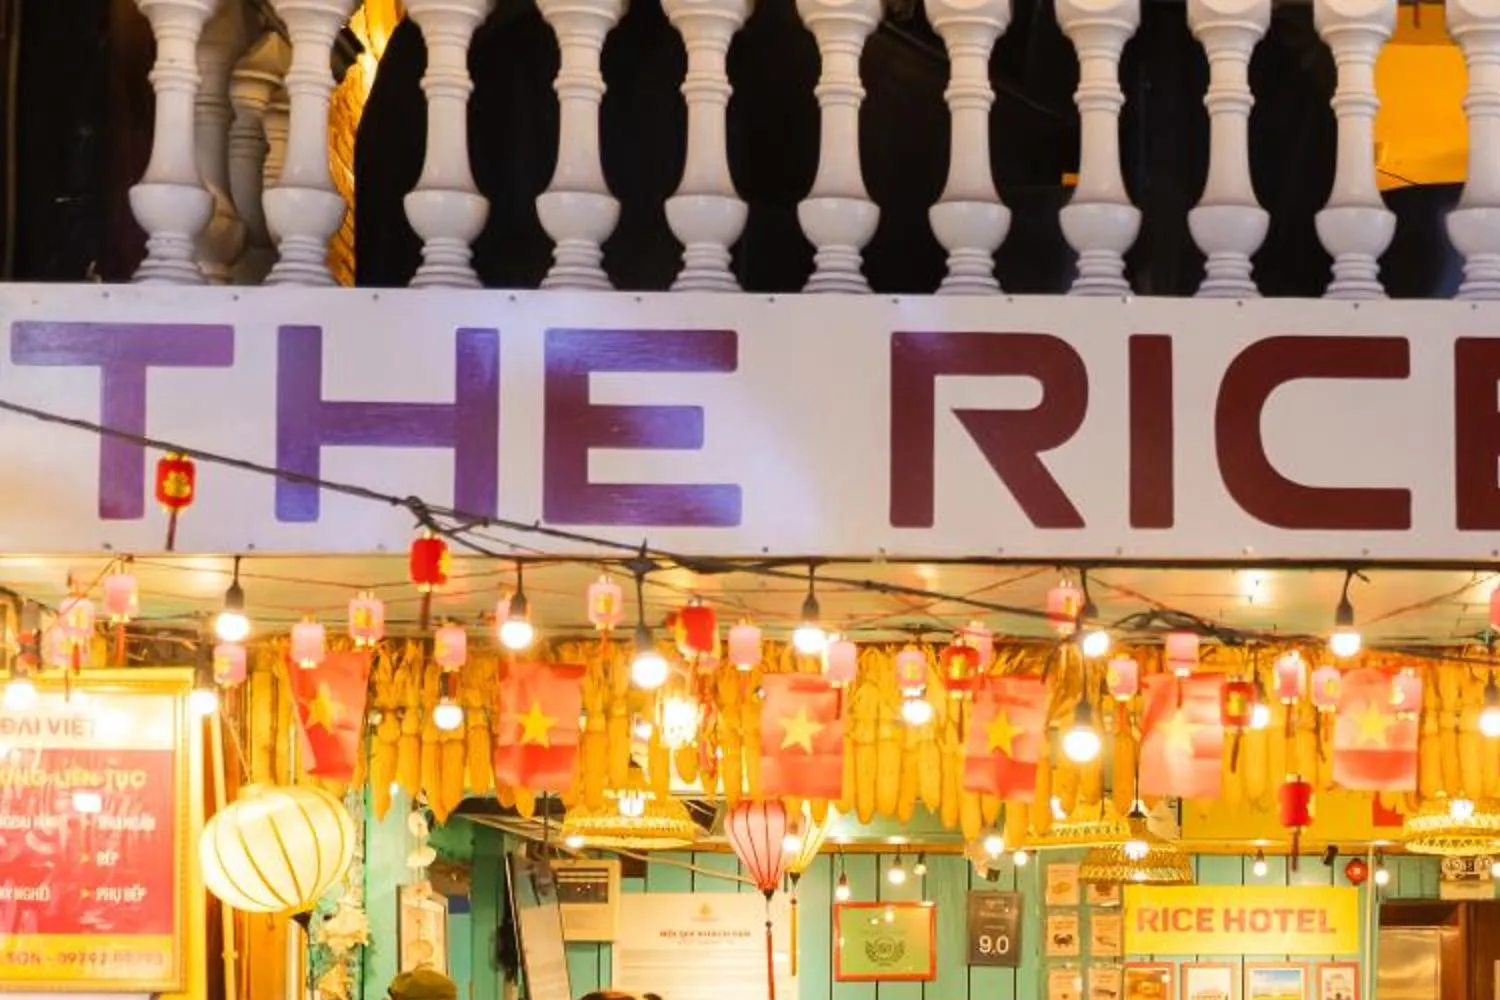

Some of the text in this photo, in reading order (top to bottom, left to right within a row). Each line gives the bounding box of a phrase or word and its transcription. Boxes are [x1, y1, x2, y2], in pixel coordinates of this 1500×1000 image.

[10, 321, 742, 528] THE
[1136, 907, 1336, 933] RICE HOTEL
